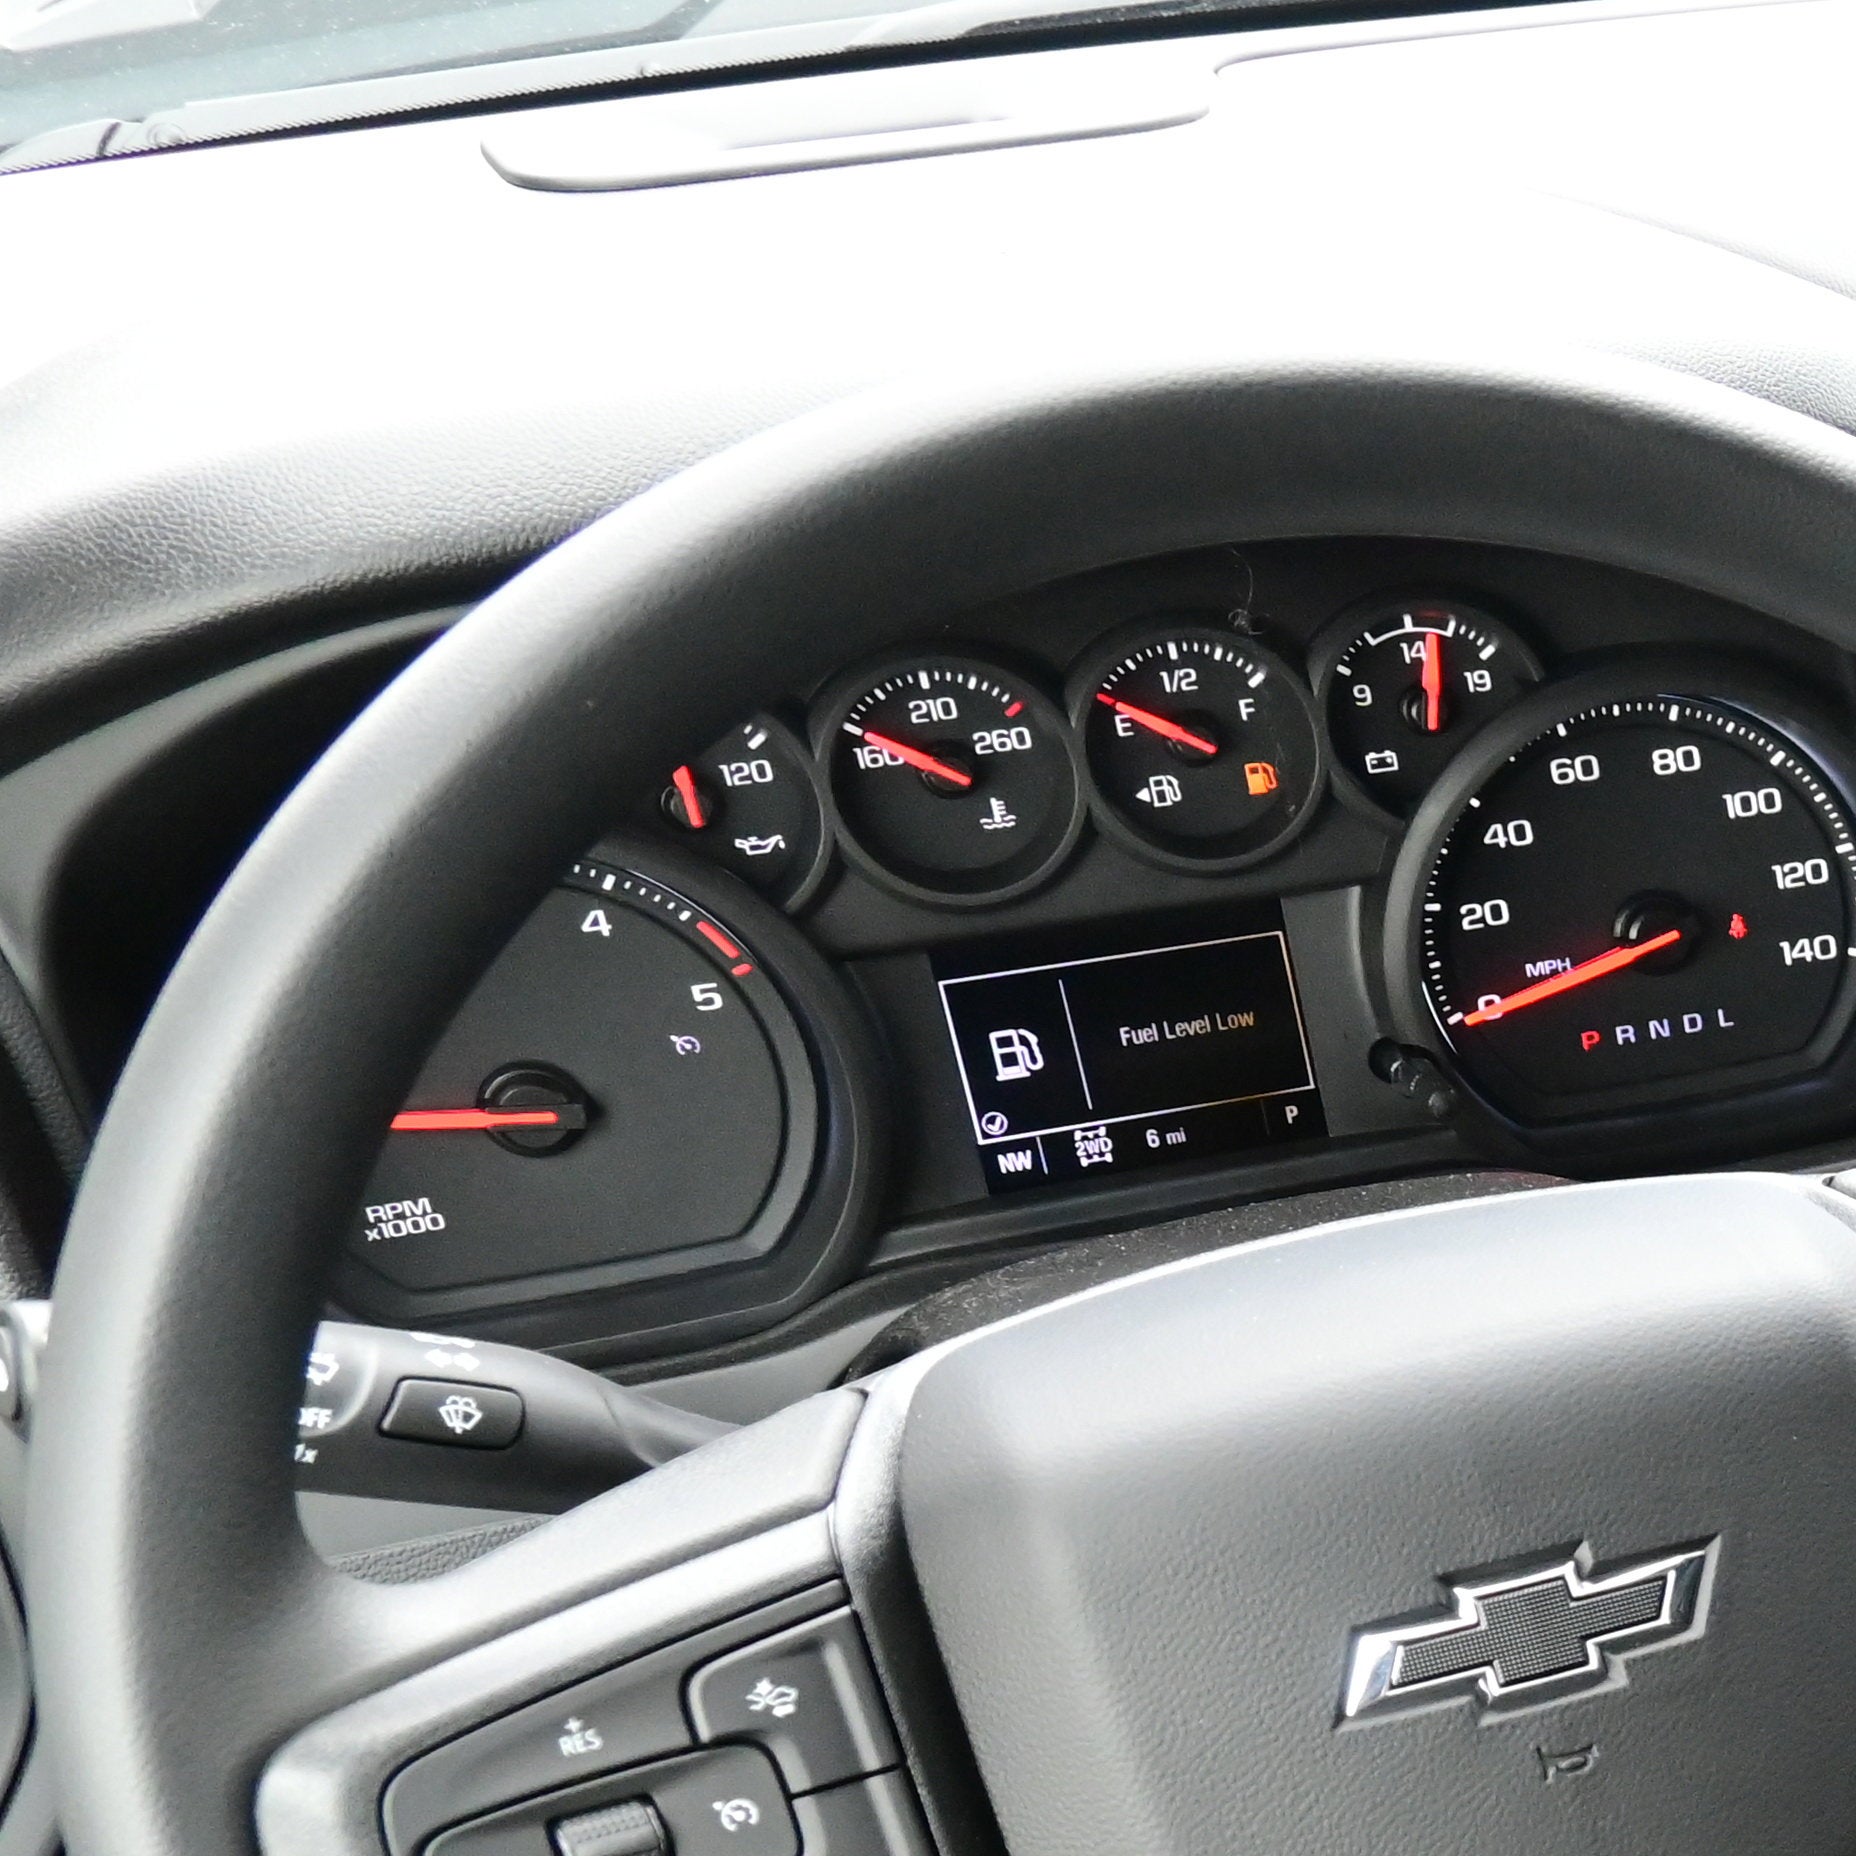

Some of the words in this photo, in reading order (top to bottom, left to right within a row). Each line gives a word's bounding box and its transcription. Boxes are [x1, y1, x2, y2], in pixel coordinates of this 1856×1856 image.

[1401, 640, 1427, 666] 14
[1160, 669, 1199, 695] 1/2
[1352, 683, 1373, 707] 9
[1464, 669, 1492, 694] 19
[908, 696, 959, 724] 210
[1238, 698, 1256, 722] F
[973, 726, 1032, 754] 260
[1115, 715, 1135, 738] E
[719, 757, 774, 787] 120
[1550, 754, 1600, 786] 60
[1652, 744, 1702, 776] 80
[1722, 787, 1783, 819] 100
[1484, 818, 1534, 850] 40
[1772, 858, 1829, 890] 120
[581, 908, 612, 937] 4
[1460, 899, 1510, 931] 20
[1778, 934, 1838, 966] 140
[1525, 957, 1573, 978] MPH
[691, 982, 724, 1012] 5
[1119, 1022, 1159, 1047] Fuel
[1164, 1014, 1212, 1040] Level
[1216, 1010, 1255, 1031] Low
[1581, 1030, 1600, 1051] P
[1615, 1024, 1636, 1046] R
[1649, 1018, 1671, 1040] N
[1683, 1012, 1704, 1034] D
[1717, 1008, 1735, 1028] L
[1284, 1105, 1299, 1125] P
[1074, 1137, 1113, 1157] 2WD
[1146, 1129, 1160, 1148] 6
[1167, 1130, 1187, 1145] mi
[997, 1149, 1033, 1175] NW
[365, 1196, 433, 1224] RPM
[364, 1212, 446, 1242] x1000
[559, 1728, 604, 1757] RES
